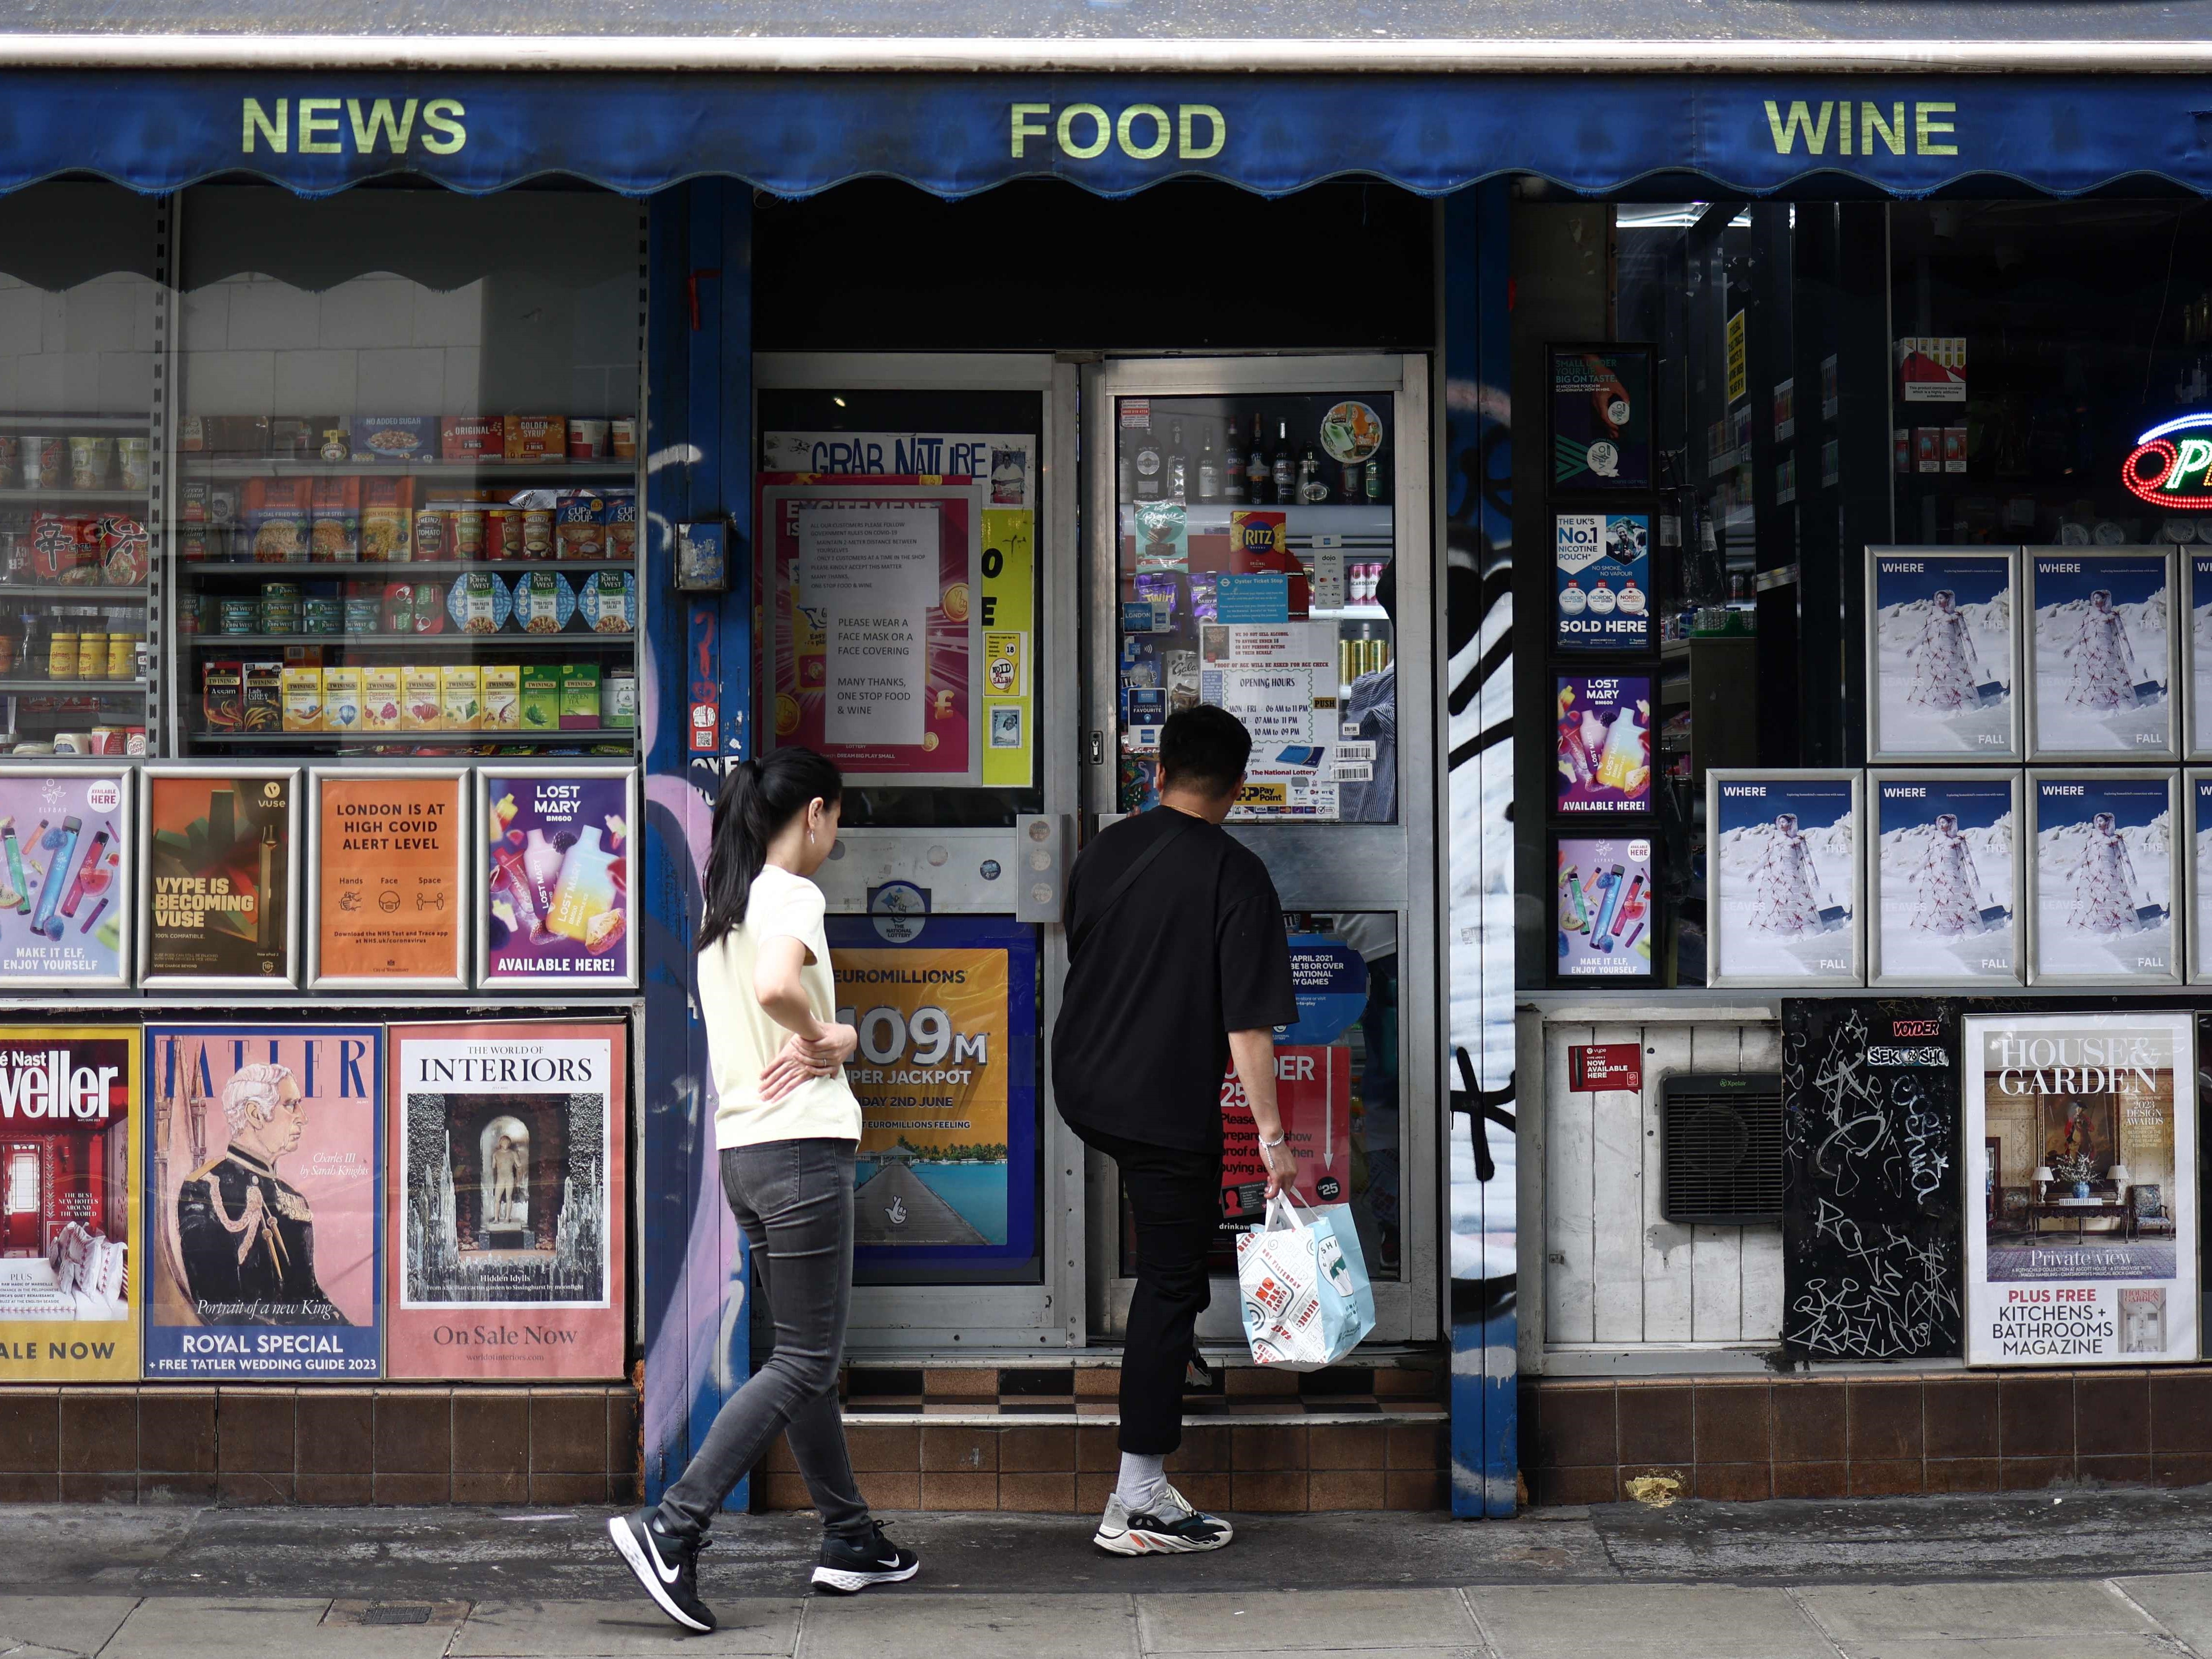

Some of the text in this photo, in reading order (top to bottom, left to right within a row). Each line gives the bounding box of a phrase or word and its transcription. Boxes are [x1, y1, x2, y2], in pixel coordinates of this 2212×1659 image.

[241, 99, 466, 155] NEWS
[1010, 103, 1226, 161] FOOD
[1765, 100, 1959, 156] WINE
[455, 426, 489, 435] ORIGINAL
[895, 437, 987, 479] NATURE
[2123, 439, 2212, 489] OP
[1245, 529, 1273, 546] RITZ
[1559, 527, 1597, 544] No.1
[34, 519, 74, 572] 辛
[1882, 563, 1924, 573] WHERE
[2039, 563, 2081, 573] WHERE
[838, 618, 909, 627] PLEASE WEAR A
[1560, 621, 1647, 632] SOLD HERE
[863, 647, 909, 655] COVERING
[838, 678, 906, 687] MANY THANKS,
[1240, 678, 1295, 688] OPENING HOURS
[1588, 680, 1619, 688] LOST
[837, 692, 857, 700] ONE
[885, 692, 911, 701] FOOD
[1586, 690, 1619, 699] MARY
[837, 706, 845, 714] &
[1314, 700, 1336, 708] PUSH
[1978, 734, 2005, 744] FALL
[2136, 734, 2162, 744] FALL
[91, 795, 116, 805] HERE
[337, 804, 446, 816] LONDON IS AT
[344, 821, 438, 832] HIGH COVID
[342, 839, 439, 850] ALERT LEVEL
[156, 877, 229, 894] VYPE IS
[155, 894, 254, 912] BECOMING
[155, 911, 205, 927] VUSE
[17, 947, 85, 960] MAKE IT ELF,
[3, 960, 98, 970] ENJOY YOURSELF
[498, 958, 615, 971] AVAILABLE HERE!
[833, 969, 965, 984] EUROMILLIONS
[1892, 1020, 1939, 1037] VOYDER
[467, 1046, 544, 1055] THE WORLD OF
[1869, 1047, 1902, 1065] SEK
[1999, 1037, 2158, 1067] HOUSE&
[12, 1051, 46, 1066] Nast
[419, 1058, 592, 1082] INTERIORS
[886, 1071, 971, 1085] JACKPOT
[1999, 1067, 2157, 1095] GARDEN
[890, 1097, 952, 1107] 2ND JUNE
[2127, 1109, 2162, 1117] DESIGN
[2032, 1250, 2134, 1266] Private view
[480, 1274, 530, 1283] Hidden Idylls
[2008, 1288, 2096, 1303] PLUS FREE
[197, 1299, 332, 1320] Portrait of a new King
[1999, 1305, 2092, 1322] KITCHENS
[433, 1325, 578, 1346] On Sale Now
[1992, 1321, 2113, 1339] BATHROOMS
[49, 1342, 116, 1359] NOW
[183, 1335, 343, 1353] ROYAL SPECIAL
[2003, 1339, 2103, 1356] MAGAZINE
[466, 1353, 544, 1362] worldofinteriors.com
[159, 1359, 376, 1370] FREE TATLER WEDDING GUIDE 2023
